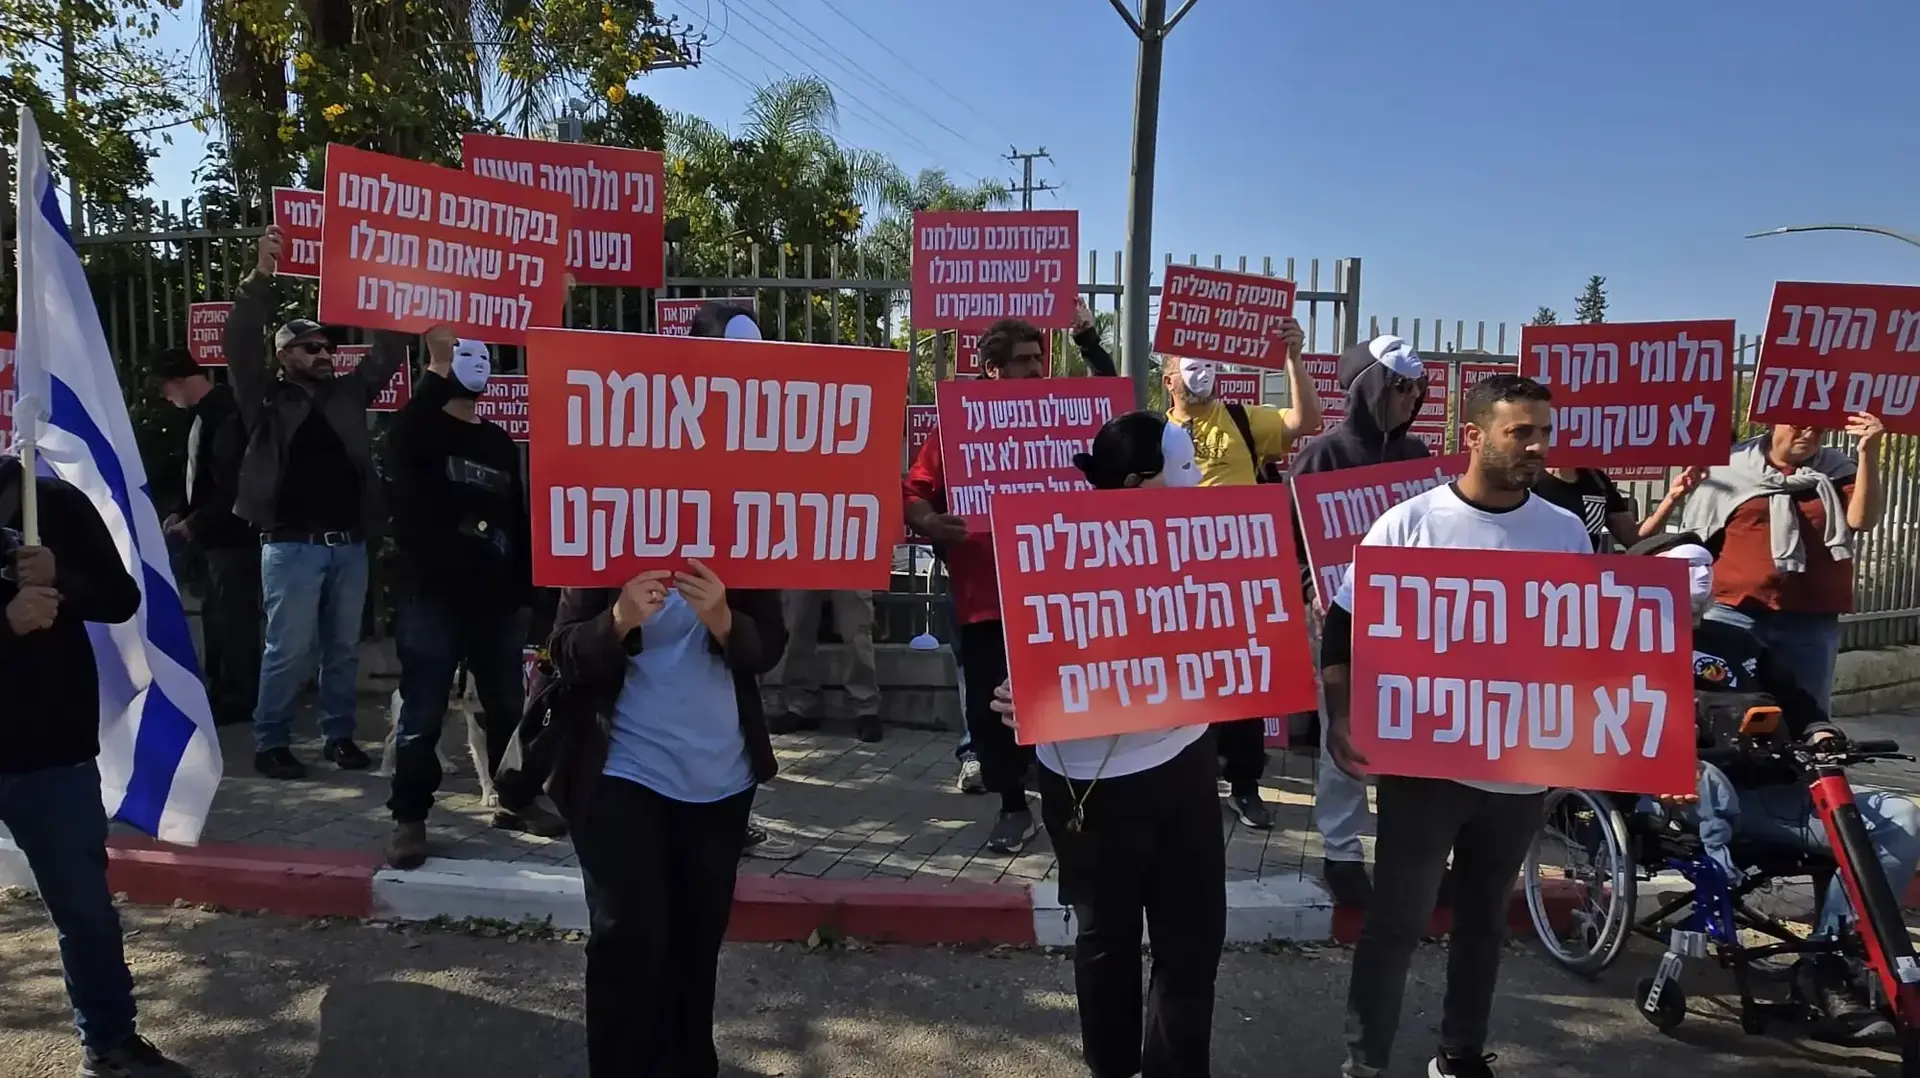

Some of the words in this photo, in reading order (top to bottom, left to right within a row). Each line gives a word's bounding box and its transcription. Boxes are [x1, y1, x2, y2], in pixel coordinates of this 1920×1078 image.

[339, 173, 431, 221] נשלחנו
[540, 160, 618, 210] מלחמה
[625, 172, 653, 213] נכי
[284, 198, 322, 228] לומי
[439, 192, 558, 246] בפקודתכם
[351, 220, 419, 268] תוכלו
[589, 231, 631, 271] נפש
[922, 223, 979, 250] נשלחנו
[985, 227, 1070, 253] בפקודתכם
[427, 239, 501, 280] שאתם
[509, 253, 544, 287] כדי
[930, 256, 973, 284] תוכלו
[979, 260, 1029, 283] שאתם
[1035, 260, 1061, 283] כדי
[358, 276, 461, 321] והופקרנו
[936, 293, 1003, 321] והופקרנו
[1008, 289, 1054, 316] לחיות
[1171, 274, 1232, 301] האפליה
[1235, 285, 1287, 309] תופסק
[467, 293, 533, 330] לחיות
[1167, 302, 1210, 325] הקרב
[1215, 308, 1259, 330] הלומי
[1776, 305, 1876, 355] הקרב
[1887, 310, 1920, 352] מי
[193, 328, 218, 342] הקרב
[1174, 329, 1220, 350] פיזיים
[1224, 336, 1270, 358] לנכים
[1530, 343, 1618, 392] הקרב
[1630, 332, 1722, 383] הלומי
[1221, 381, 1255, 395] תופסק
[1757, 367, 1837, 414] צדק
[1843, 373, 1920, 417] שים
[567, 370, 872, 454] פוסטראומה
[962, 396, 985, 432] על
[988, 400, 1037, 429] בנפשו
[1039, 393, 1092, 427] ששילם
[1095, 398, 1112, 425] מי
[1668, 395, 1715, 445] לא
[959, 443, 996, 477] צריך
[999, 436, 1018, 470] לא
[1024, 435, 1083, 469] המולדת
[550, 487, 715, 571] בשקט
[731, 492, 879, 560] הורגת
[1016, 513, 1157, 572] האפליה
[1166, 514, 1277, 572] תופסק
[1024, 590, 1127, 649] הקרב
[1135, 575, 1234, 633] הלומי
[1241, 579, 1288, 634] בין
[1368, 574, 1506, 653] הקרב
[1525, 571, 1675, 653] הלומי
[1059, 657, 1167, 714] פיזיים
[1177, 638, 1270, 700] לנכים
[1378, 675, 1573, 760] שקופים
[1593, 675, 1666, 757] לא
